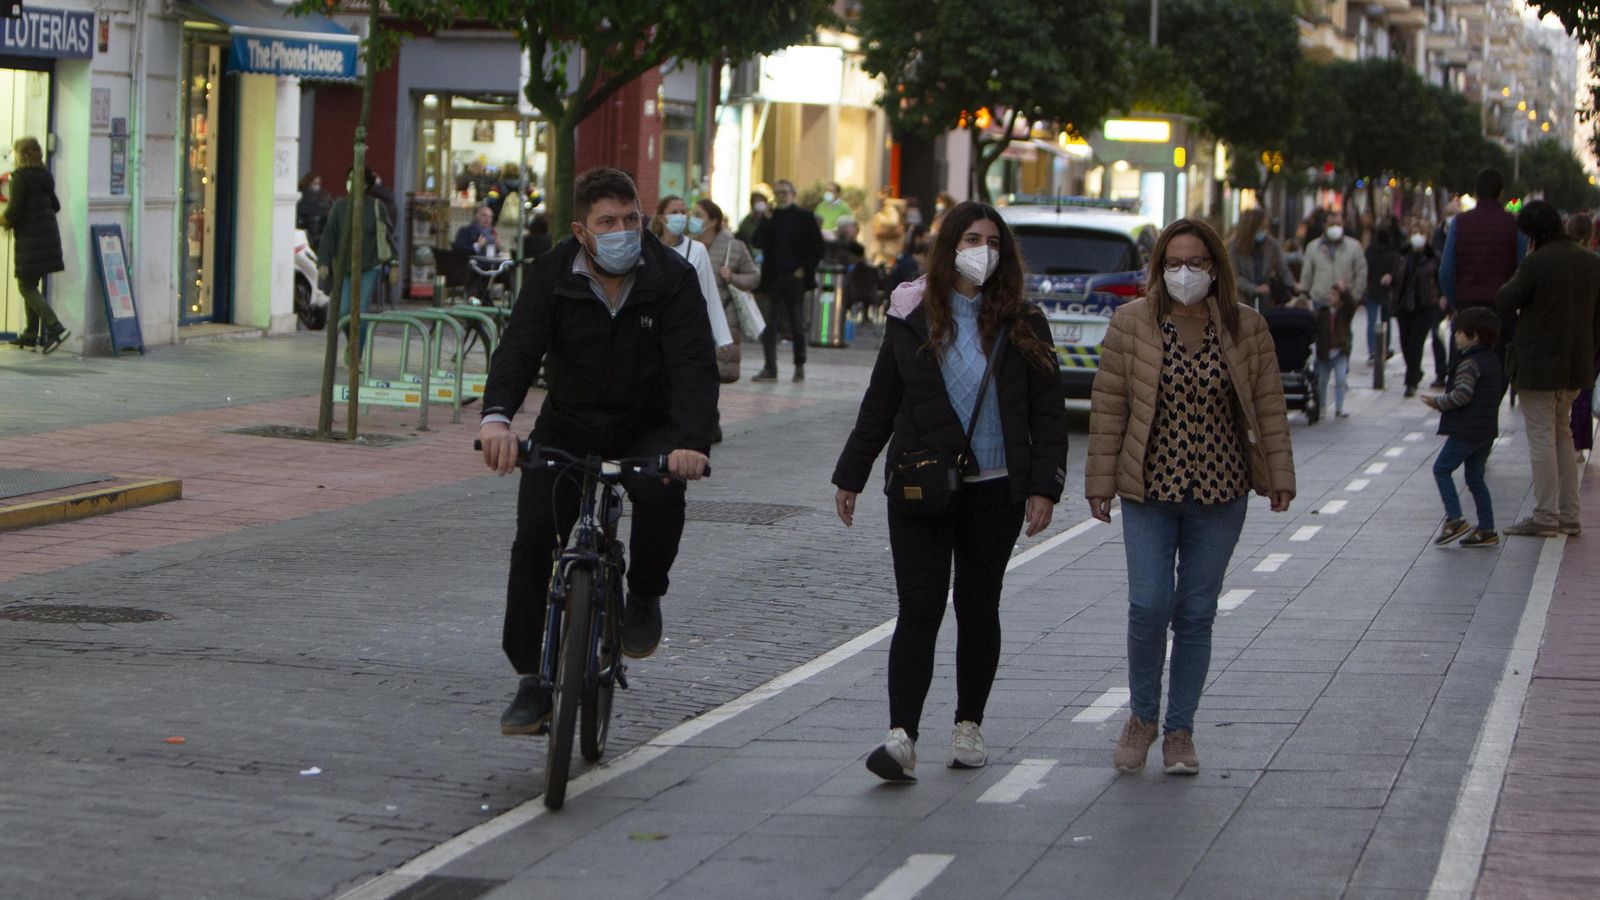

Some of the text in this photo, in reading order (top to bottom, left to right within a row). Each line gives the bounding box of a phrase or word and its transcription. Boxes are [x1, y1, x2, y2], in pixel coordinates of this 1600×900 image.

[4, 9, 90, 53] LOTERÍAS
[247, 39, 344, 72] The Phone House
[1054, 301, 1114, 317] LOCA
